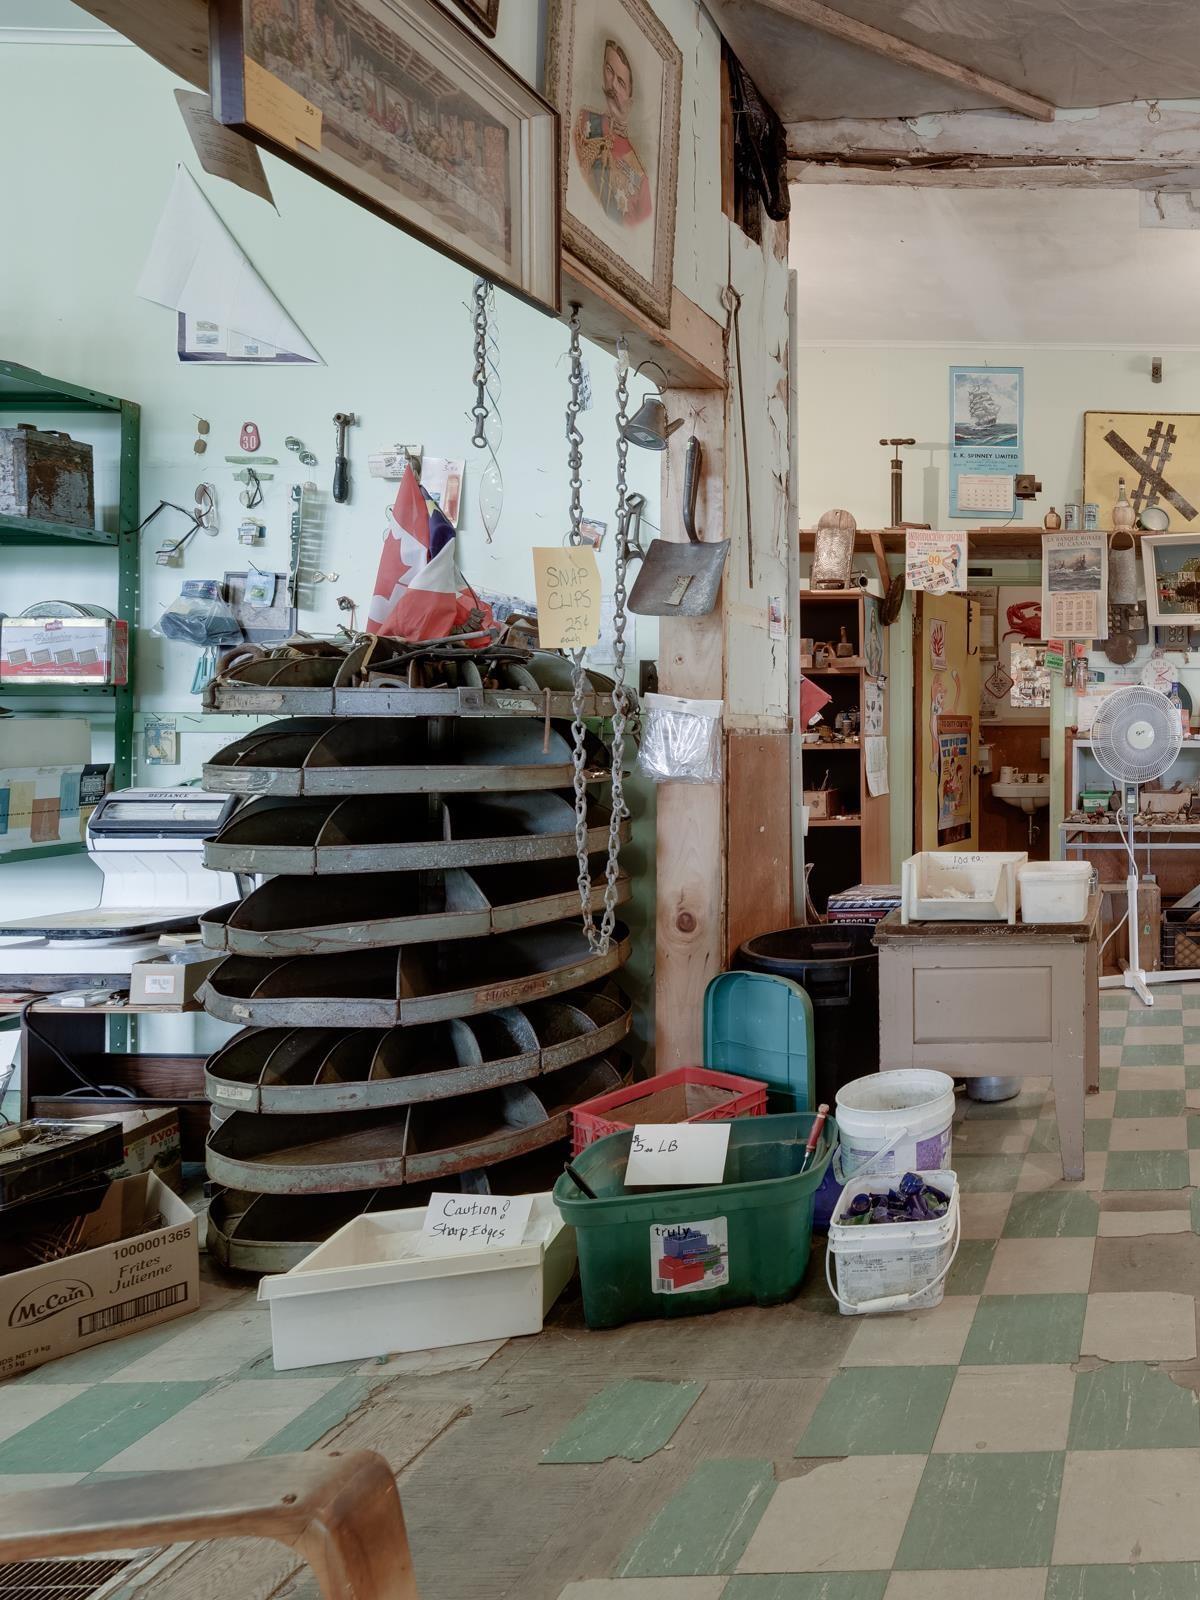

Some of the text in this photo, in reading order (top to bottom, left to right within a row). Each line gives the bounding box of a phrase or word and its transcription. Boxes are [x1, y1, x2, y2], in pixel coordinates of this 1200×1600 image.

[242, 435, 257, 450] 30
[546, 566, 589, 588] SNAP
[547, 588, 592, 610] CLIPS
[658, 1139, 678, 1153] LB
[468, 1223, 505, 1245] Edges
[654, 1225, 690, 1239] truly
[113, 1227, 191, 1261] 1000001365
[119, 1254, 161, 1279] Frites
[109, 1262, 173, 1295] Julienne
[17, 1286, 85, 1323] McCain
[15, 1350, 33, 1362] NET
